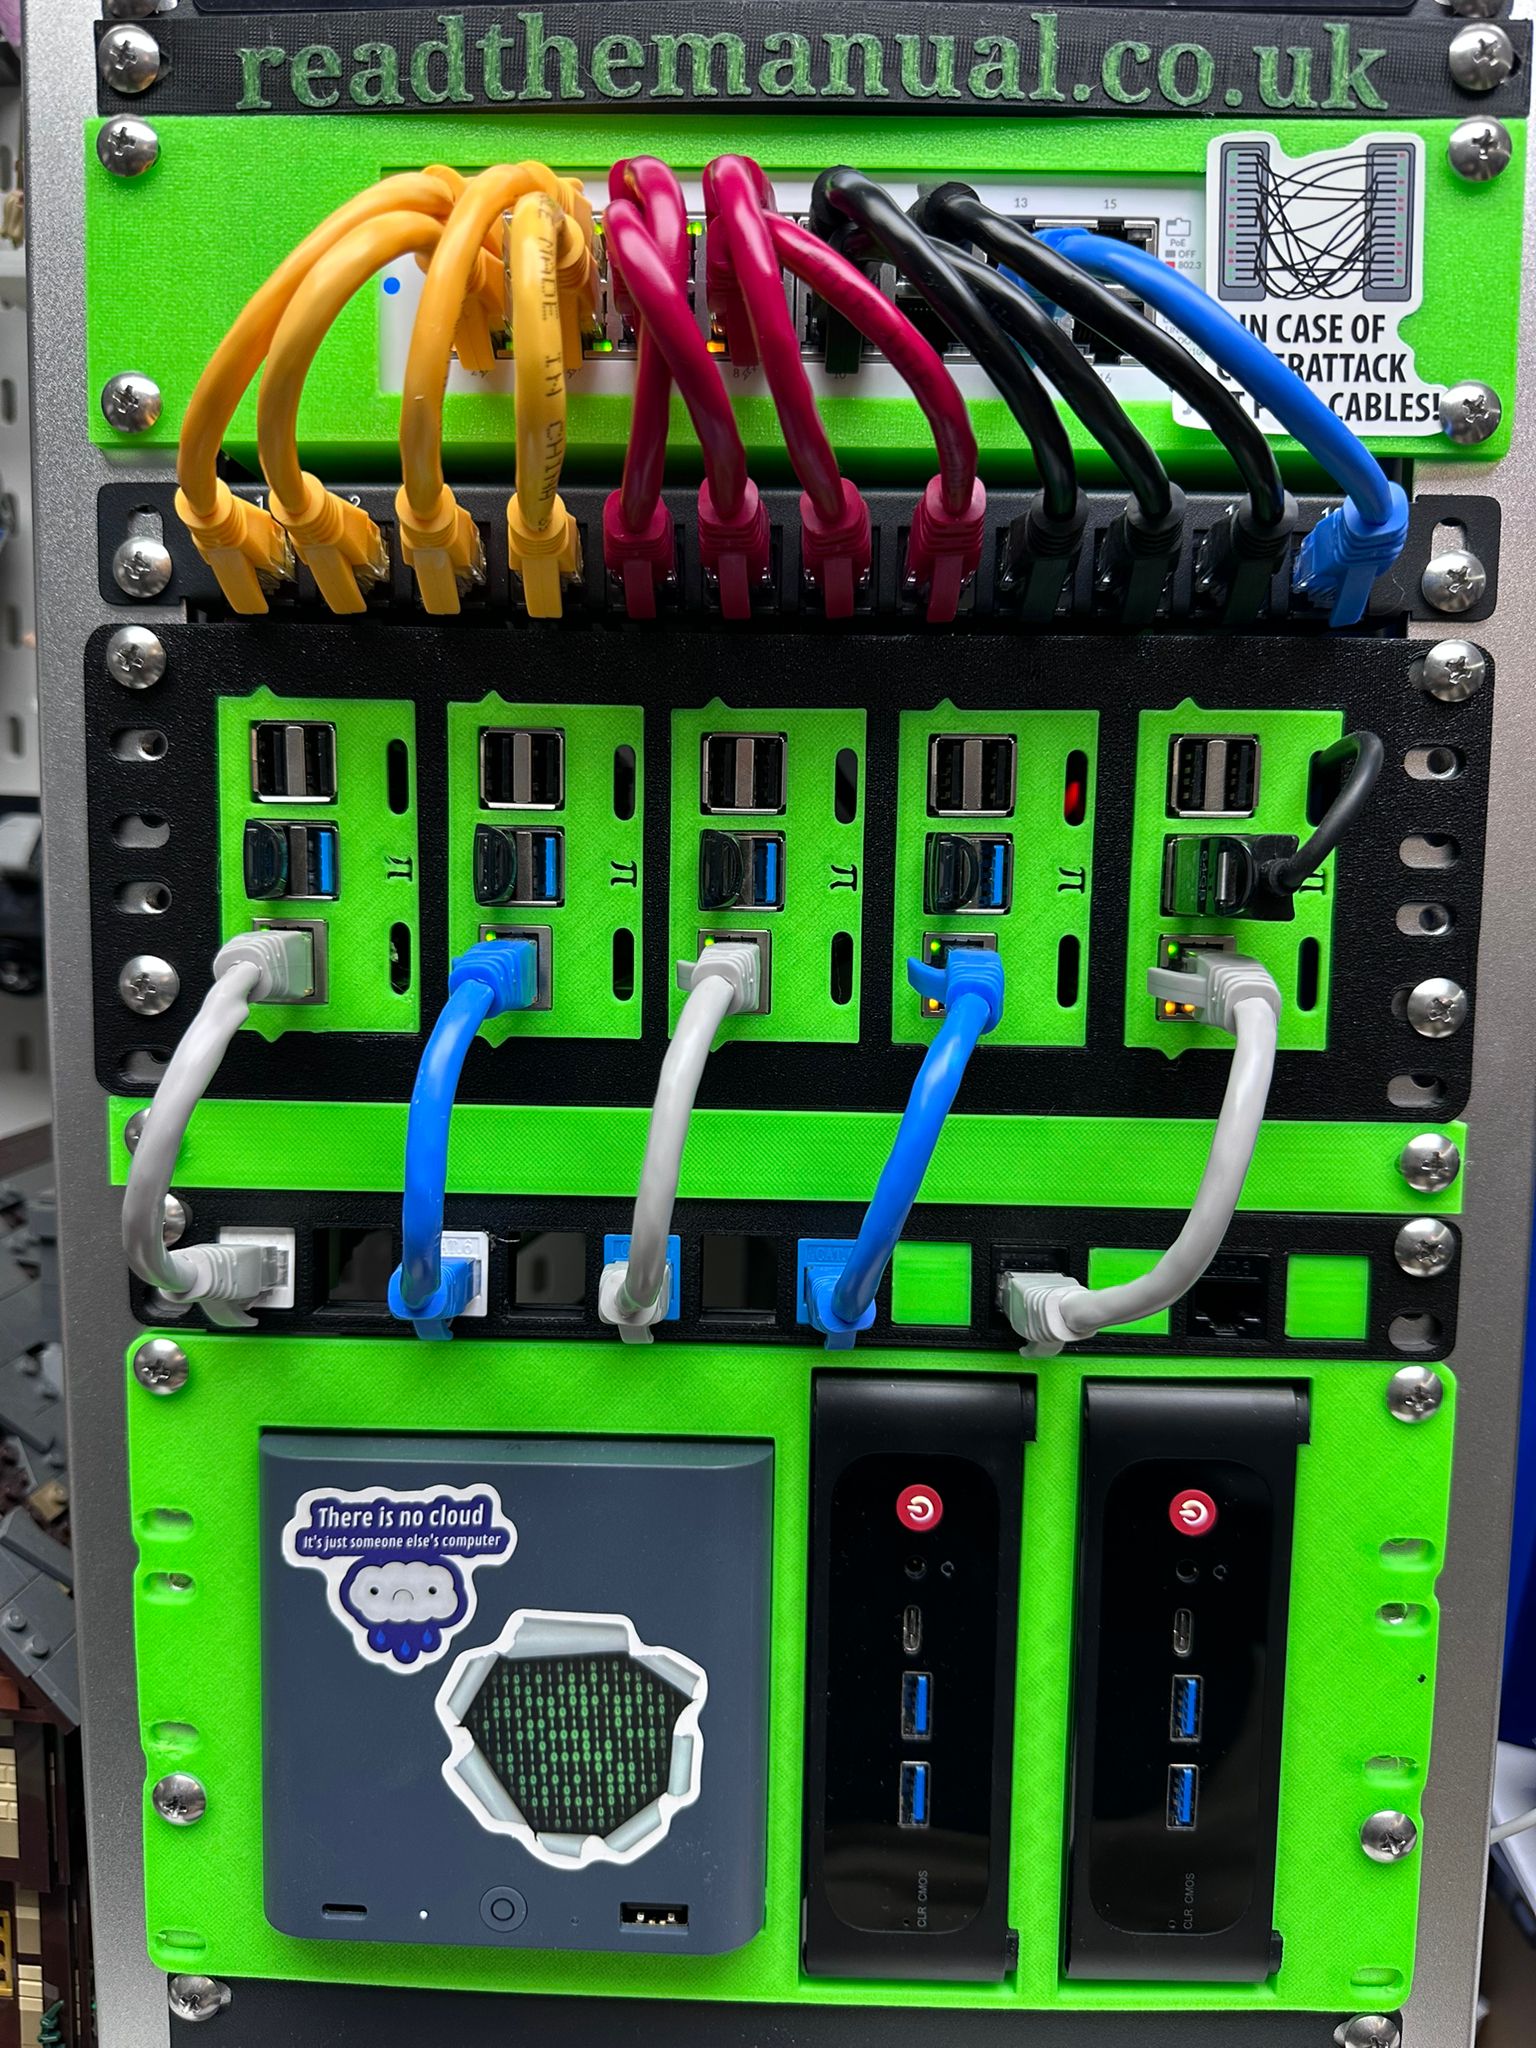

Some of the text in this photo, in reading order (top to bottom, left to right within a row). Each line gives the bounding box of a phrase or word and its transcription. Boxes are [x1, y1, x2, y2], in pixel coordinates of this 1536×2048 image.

[235, 12, 1388, 111] readthemanual.co.uk
[1014, 197, 1028, 208] 13
[1104, 199, 1117, 209] 15
[1170, 239, 1186, 247] PoE
[1178, 250, 1196, 258] OFF
[1276, 314, 1343, 343] CASE
[1351, 314, 1386, 343] OF
[1328, 392, 1440, 422] CABLES!
[318, 1503, 484, 1528] There is no cloud
[303, 1533, 502, 1551] It's just someone else's computer
[917, 1870, 928, 1928] CLR CMOS
[1183, 1872, 1195, 1929] CLR CMOS
